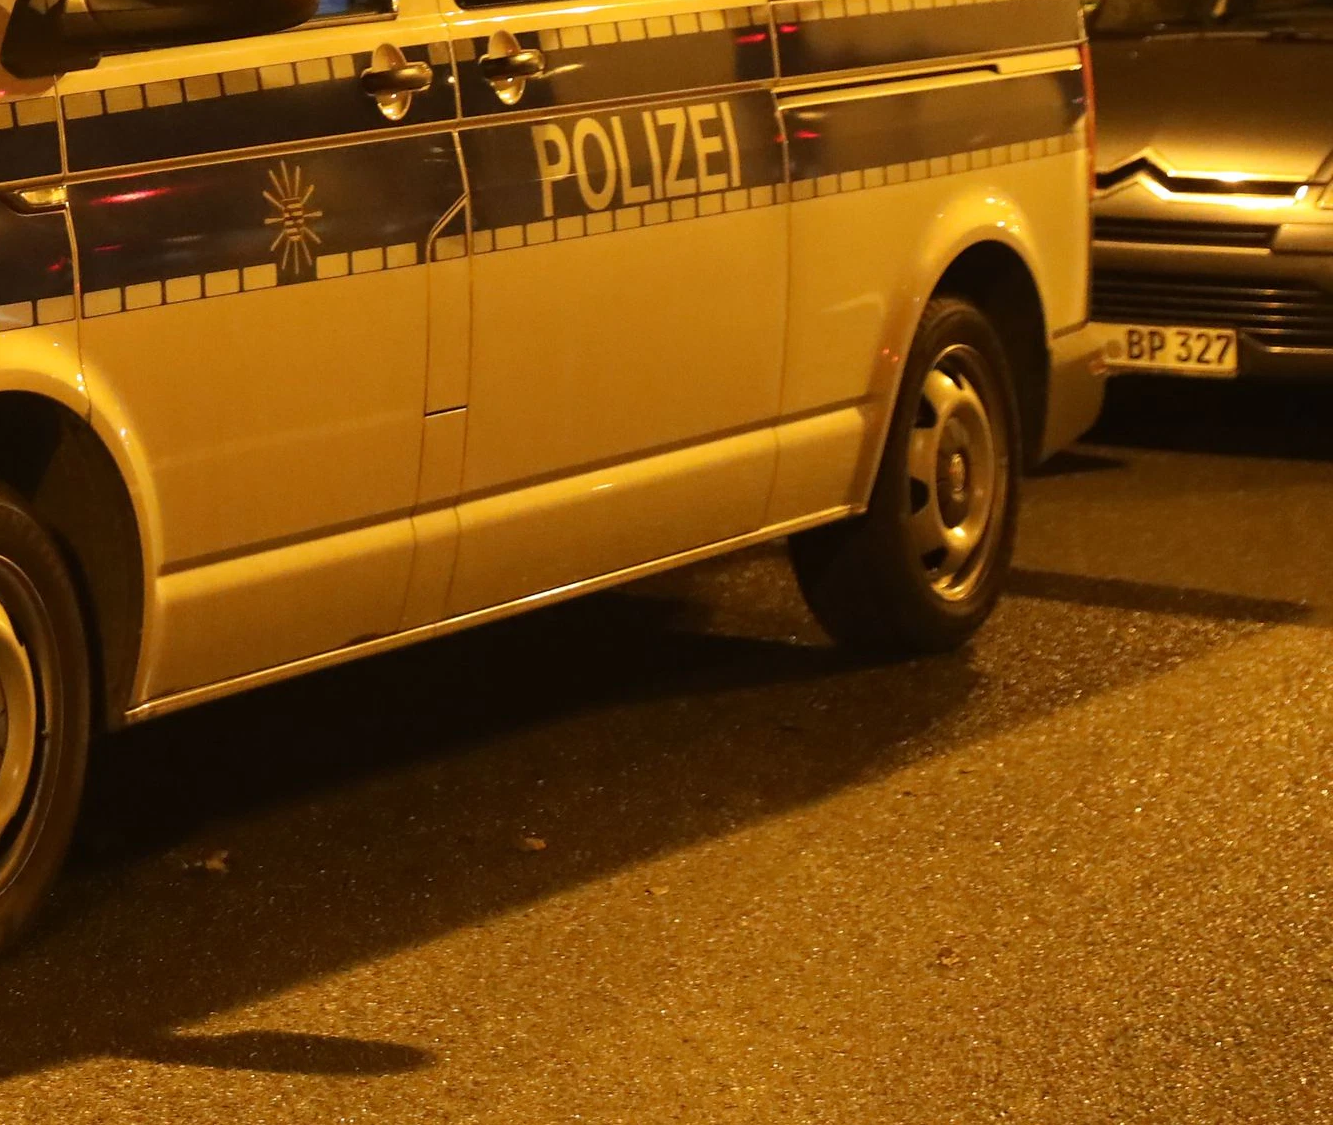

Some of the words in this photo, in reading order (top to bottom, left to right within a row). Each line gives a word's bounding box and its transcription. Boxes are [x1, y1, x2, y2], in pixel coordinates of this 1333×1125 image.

[531, 101, 742, 218] POLIZEI
[1126, 328, 1165, 361] BP
[1175, 331, 1231, 364] 327
